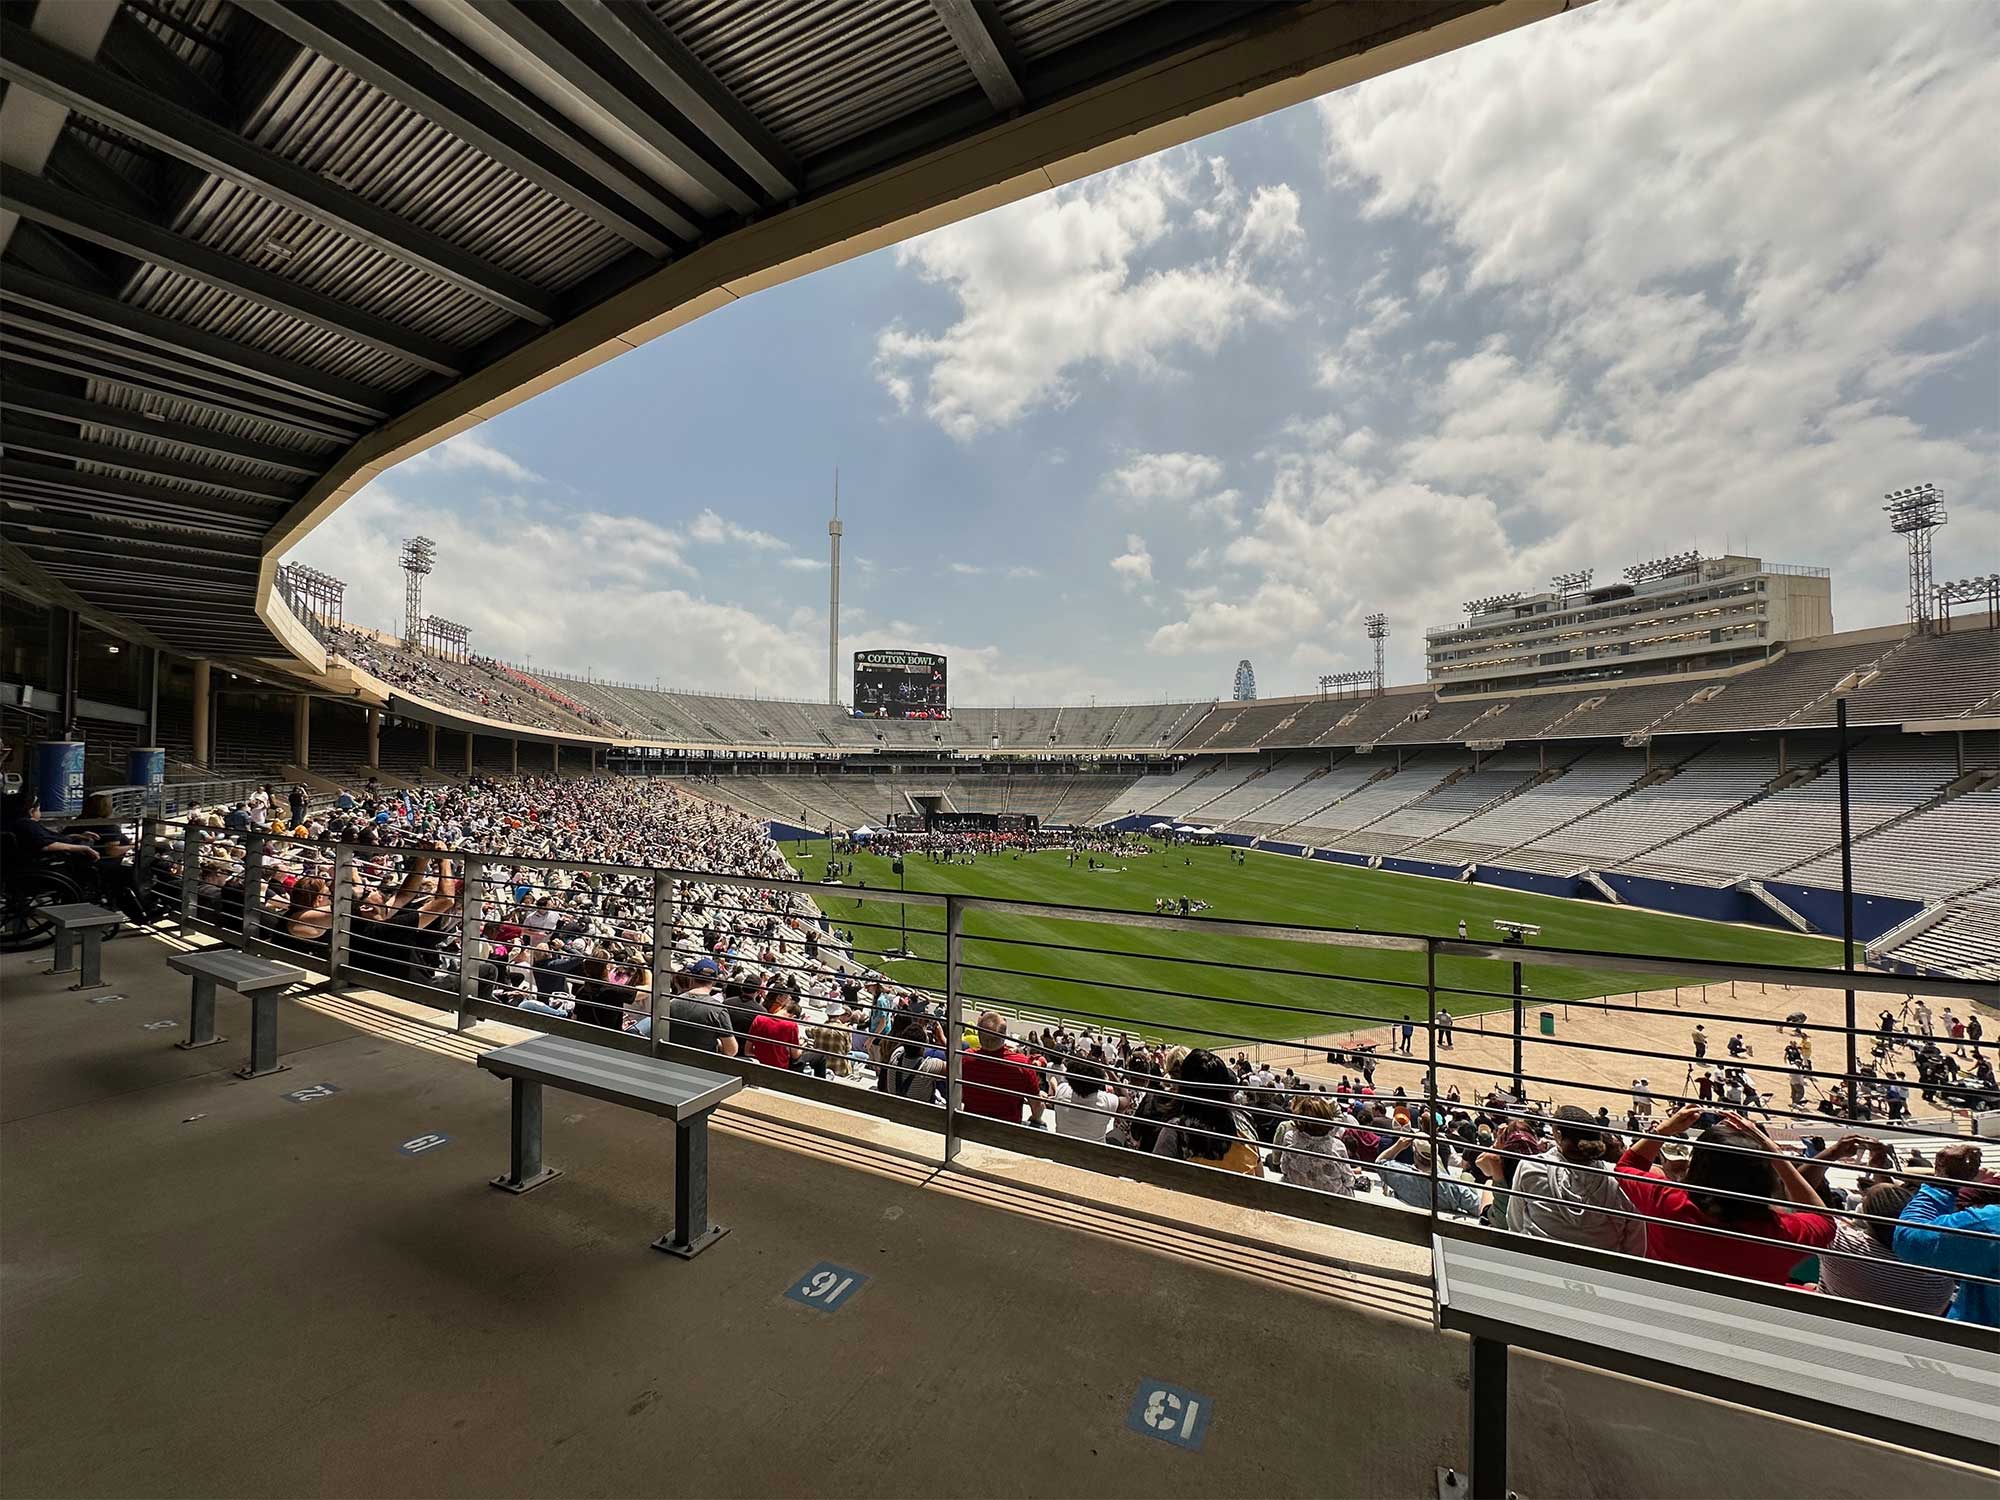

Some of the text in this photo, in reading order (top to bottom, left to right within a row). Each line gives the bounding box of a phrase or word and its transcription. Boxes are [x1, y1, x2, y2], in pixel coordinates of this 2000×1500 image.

[867, 654, 936, 666] COTTON BOWL
[403, 1134, 447, 1152] 19
[802, 1271, 854, 1304] 16
[1143, 1390, 1199, 1440] 13
